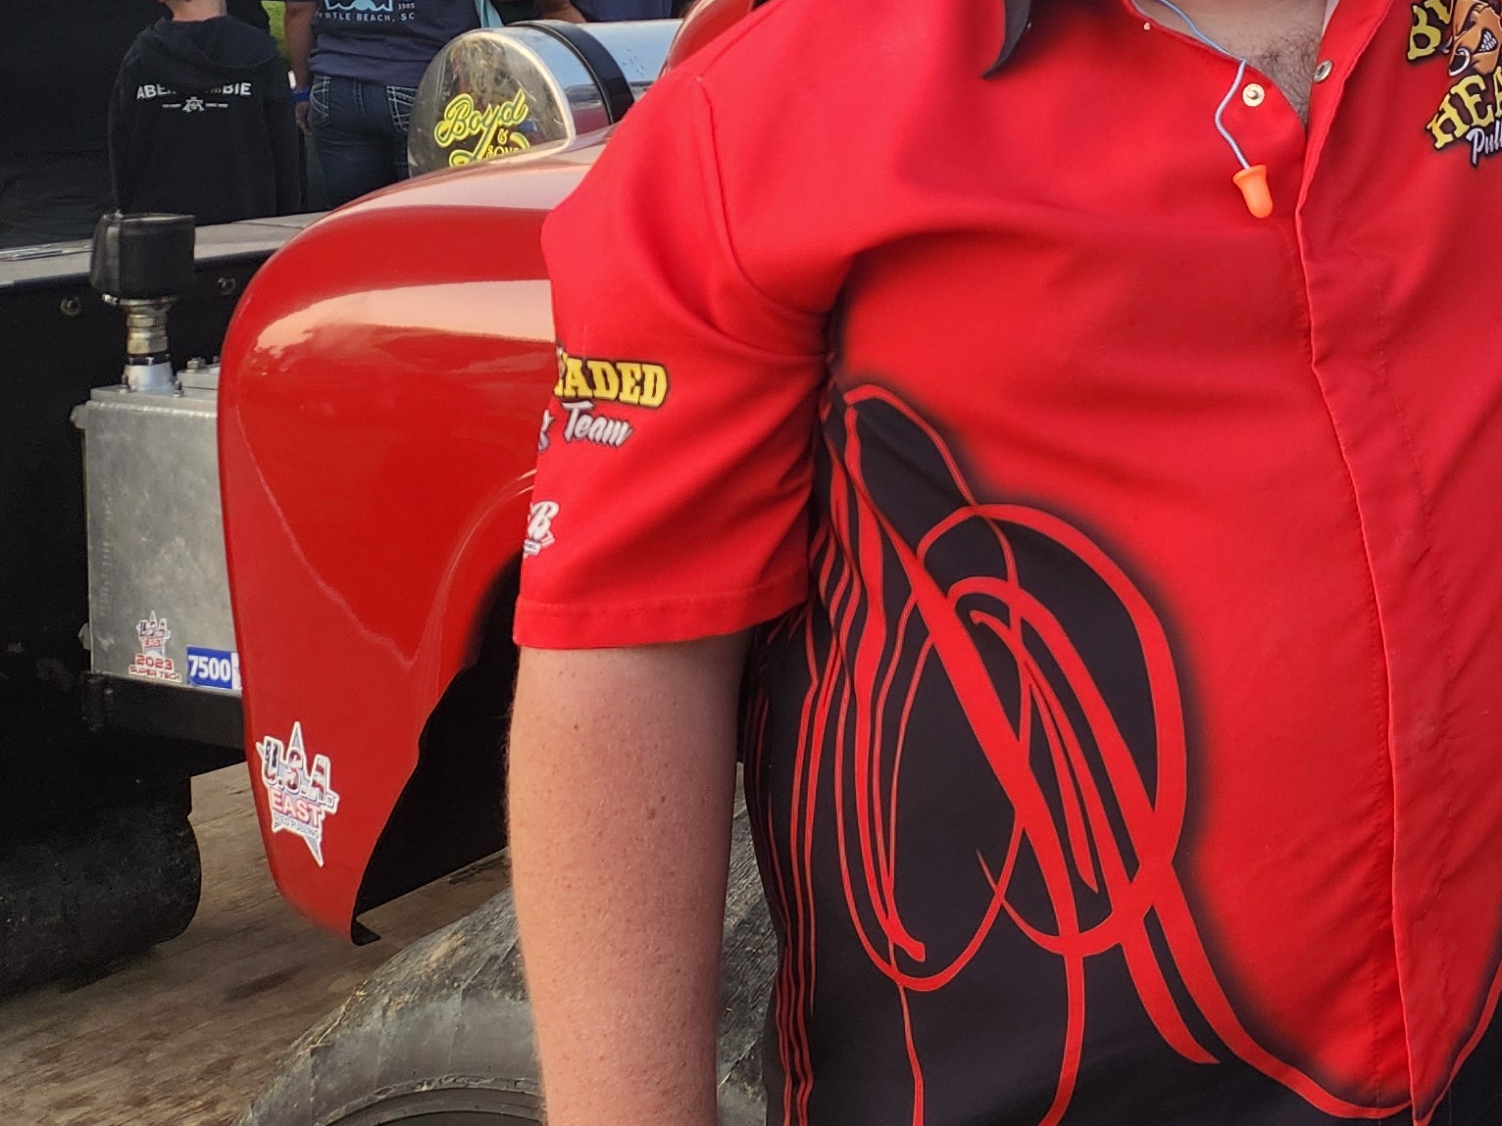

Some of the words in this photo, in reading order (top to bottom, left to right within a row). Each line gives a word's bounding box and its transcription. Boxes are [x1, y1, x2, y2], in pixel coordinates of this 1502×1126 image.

[136, 82, 252, 100] ABEBIE
[433, 88, 529, 169] Boyd
[561, 401, 634, 448] Team
[136, 654, 174, 671] 2023
[187, 654, 232, 683] 7500
[271, 790, 323, 827] EAST
